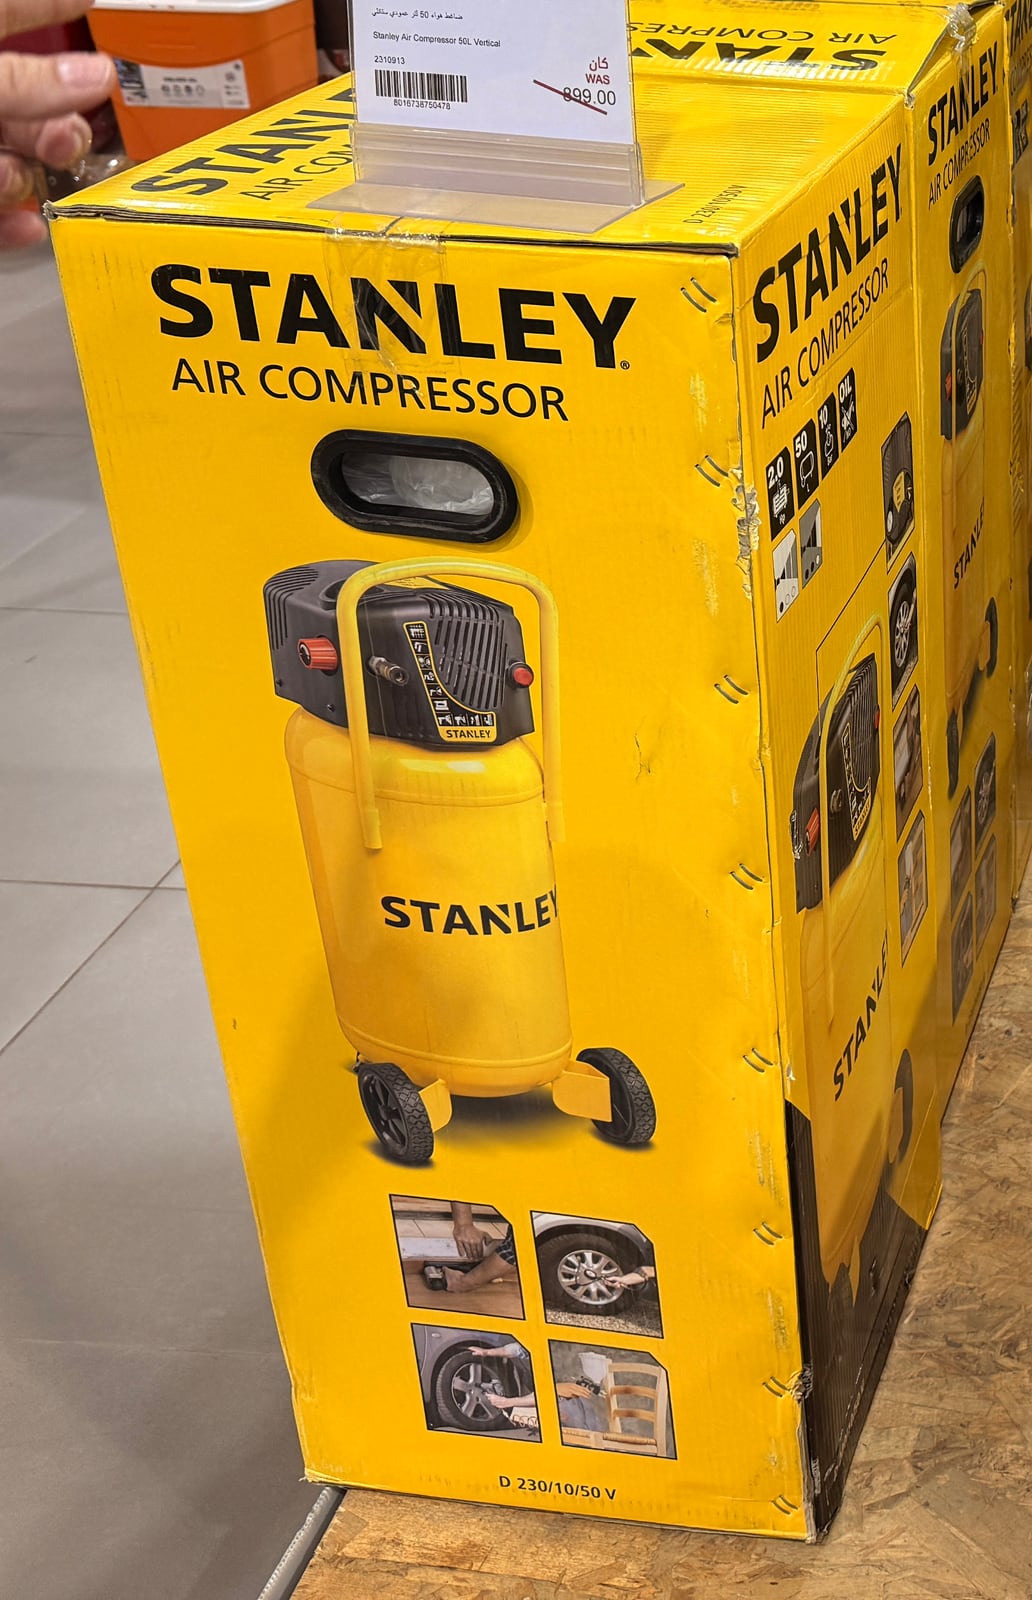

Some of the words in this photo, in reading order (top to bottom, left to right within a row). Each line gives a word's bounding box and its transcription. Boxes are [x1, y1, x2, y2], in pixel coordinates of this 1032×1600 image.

[389, 10, 409, 18] عمودي
[419, 11, 429, 19] 50
[430, 11, 443, 20] هواء
[373, 31, 400, 42] Stanley
[400, 33, 411, 41] Air
[413, 34, 457, 45] Compressor
[458, 37, 472, 46] 50L
[473, 38, 501, 48] Vertical
[829, 32, 897, 45] AIR
[374, 55, 406, 65] 2310913
[589, 56, 609, 72] كان
[585, 73, 610, 85] WAS
[563, 87, 616, 106] 899.00
[928, 41, 998, 167] STANLEY
[131, 87, 357, 196] STAN
[928, 172, 942, 211] AIR
[942, 117, 991, 191] COMPRESSOR
[239, 177, 313, 201] AIR
[752, 143, 902, 364] STANLEY
[150, 263, 637, 370] STANLEY
[762, 366, 793, 430] AIR
[797, 257, 889, 388] COMPRESSOR
[171, 357, 248, 396] AIR
[258, 363, 570, 422] COMPRESSOR
[839, 375, 852, 403] OIL
[819, 405, 829, 430] 10
[794, 430, 808, 458] 50
[768, 456, 784, 490] 2.0
[954, 495, 984, 590] STANLE
[446, 729, 491, 739] STANLEY
[380, 884, 558, 936] STANLEY
[833, 929, 888, 1102] STANLE
[499, 1475, 511, 1488] D
[517, 1477, 601, 1499] 230/10/50
[605, 1487, 617, 1500] V
